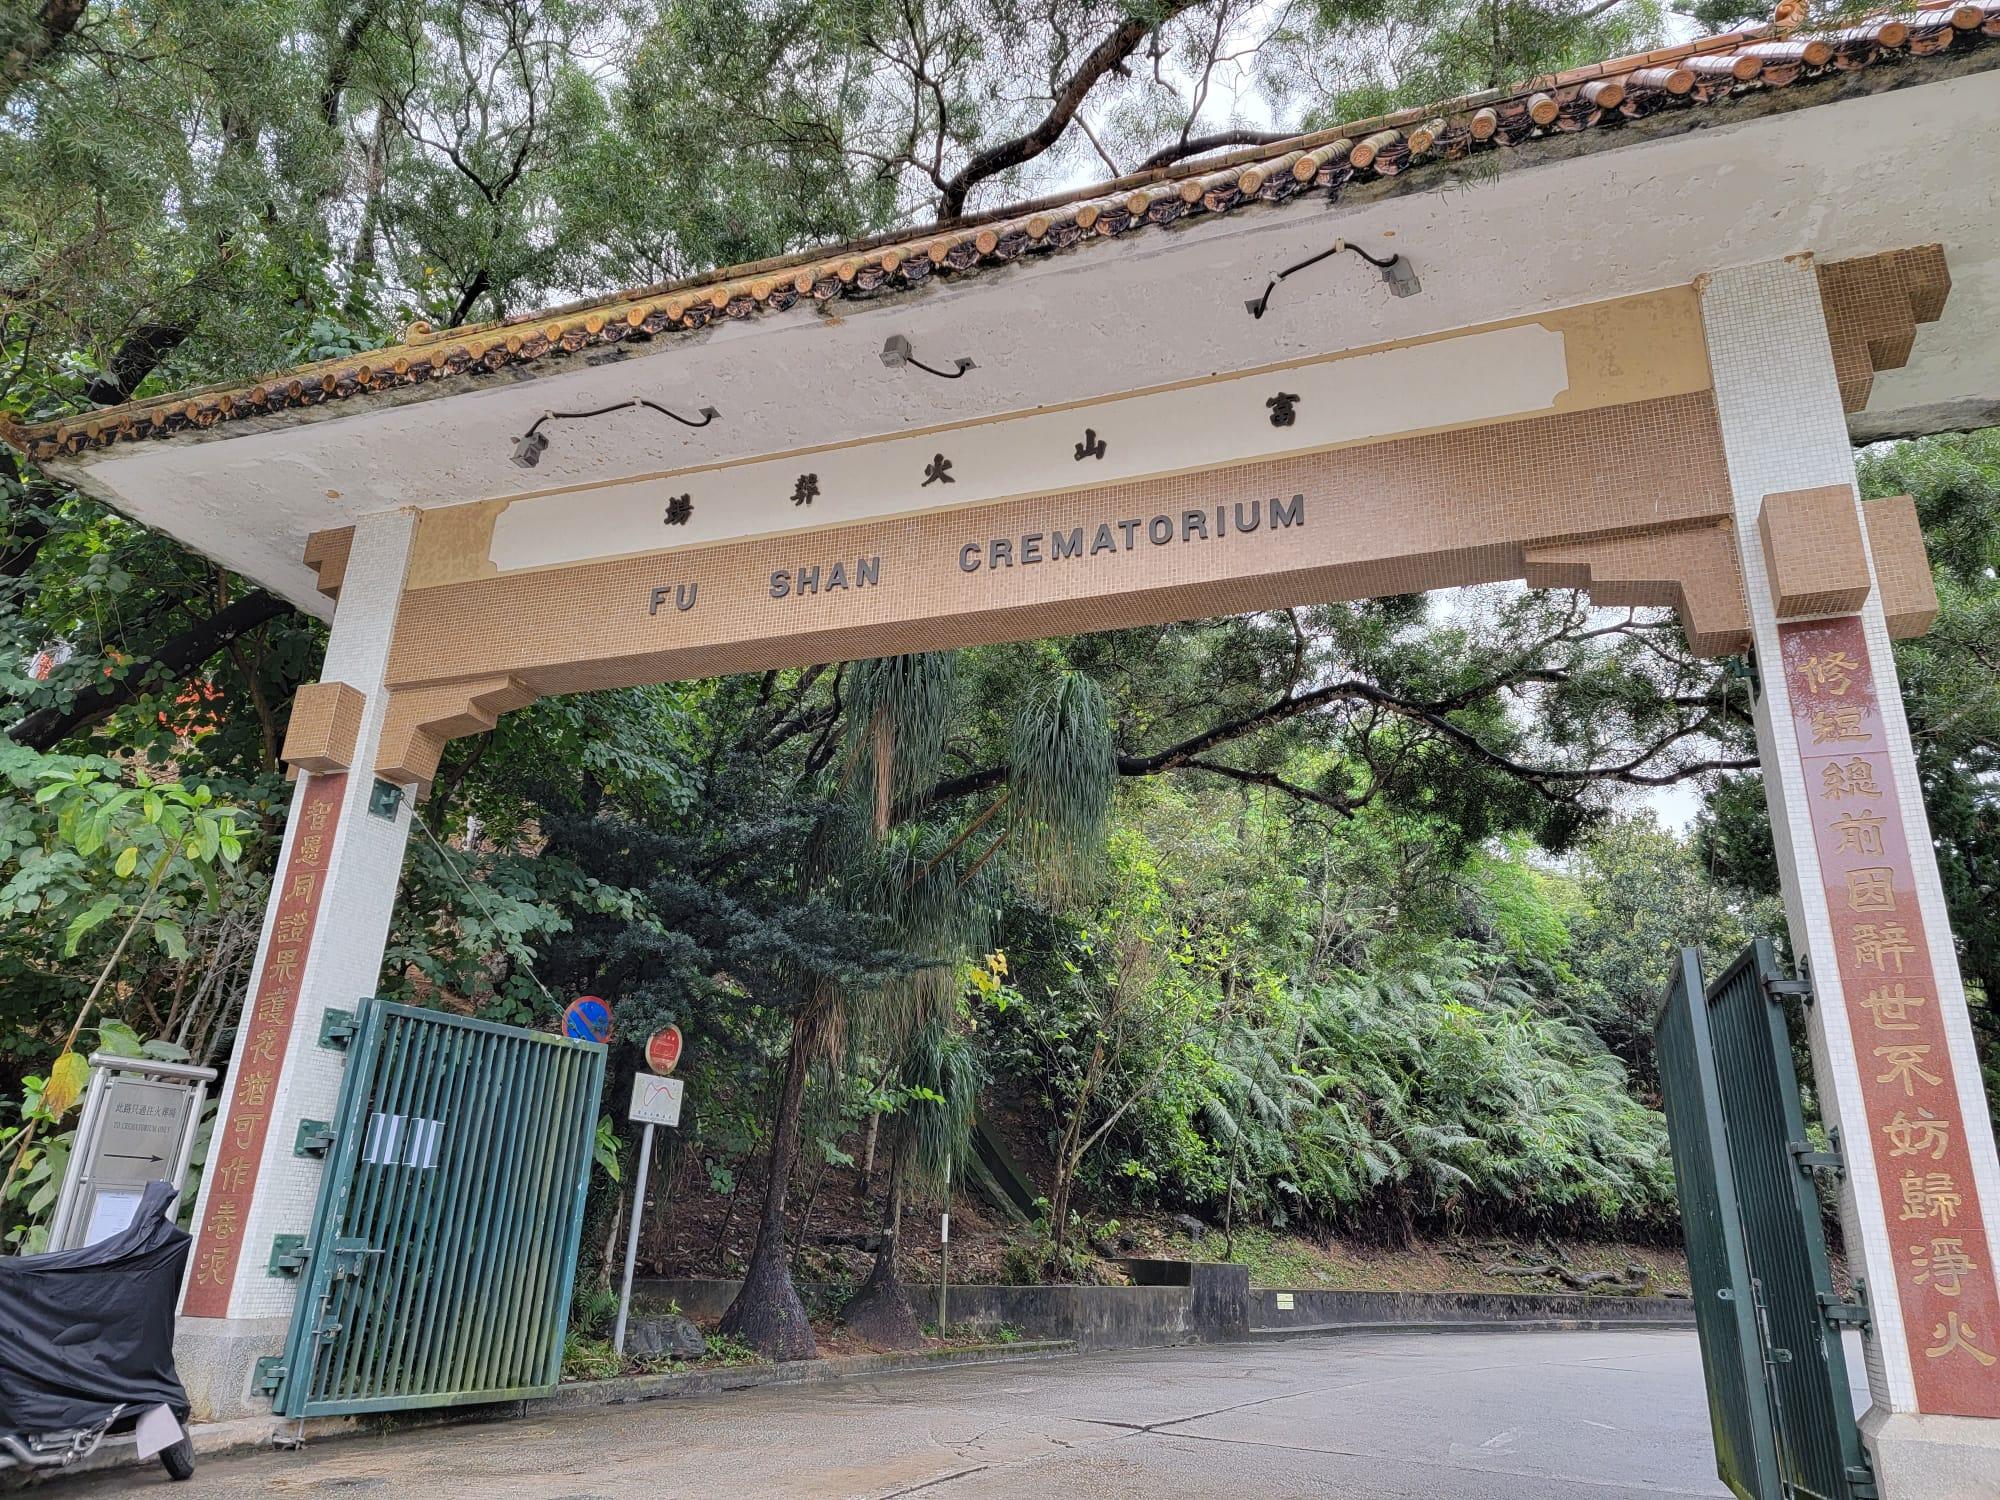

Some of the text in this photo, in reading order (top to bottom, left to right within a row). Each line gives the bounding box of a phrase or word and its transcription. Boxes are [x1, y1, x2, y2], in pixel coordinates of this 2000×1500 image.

[649, 494, 1305, 615] FU SHAN CREMATORIUM
